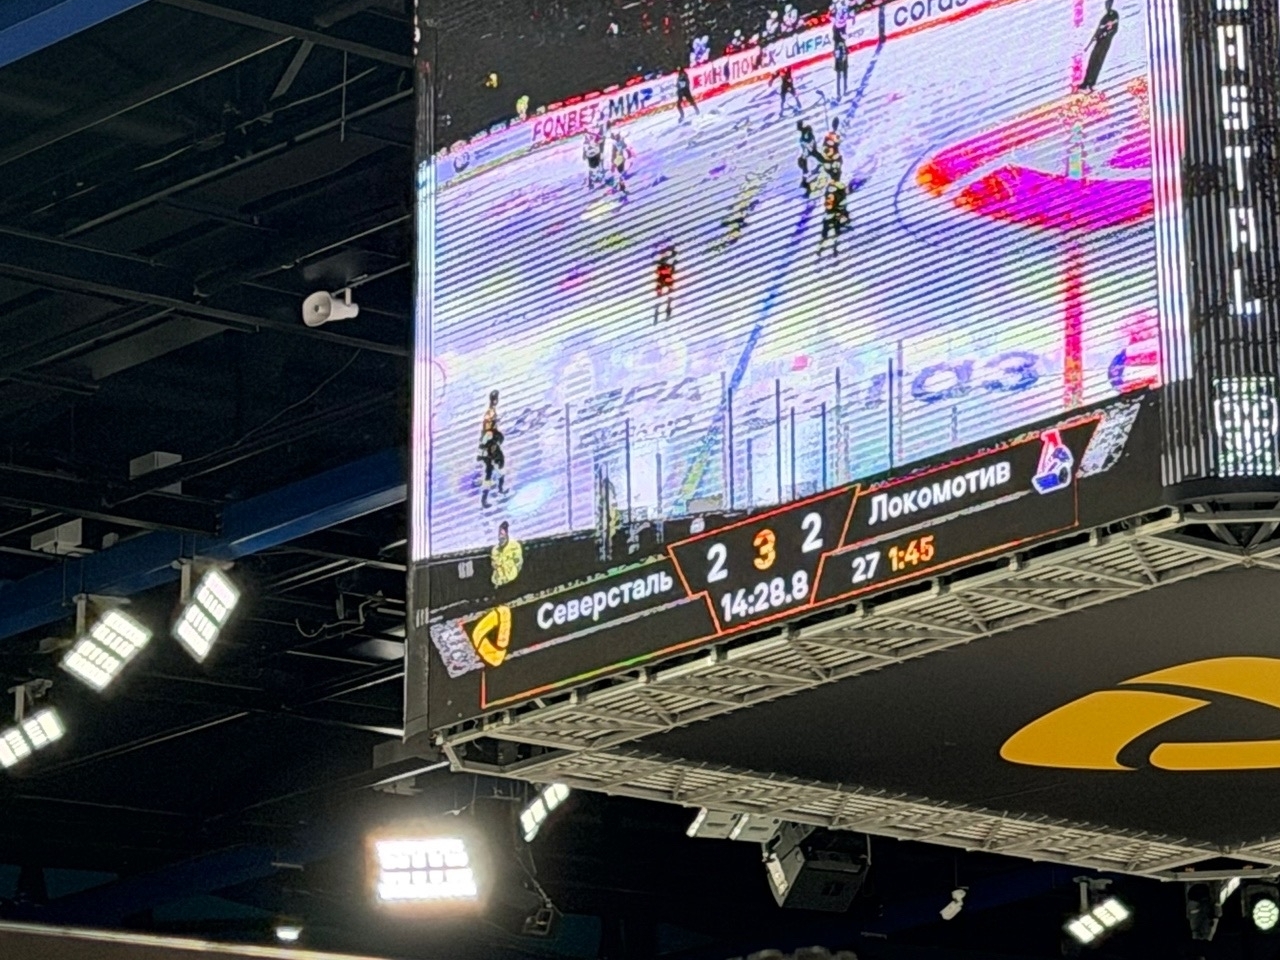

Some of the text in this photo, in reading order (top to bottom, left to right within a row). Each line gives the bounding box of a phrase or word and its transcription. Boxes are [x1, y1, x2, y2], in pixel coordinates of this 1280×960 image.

[868, 461, 1011, 526] Локомотив
[706, 512, 824, 584] 2 3 2
[851, 535, 935, 584] 27 1:45
[536, 570, 674, 630] Северсталь
[720, 569, 809, 623] 14:28.8
